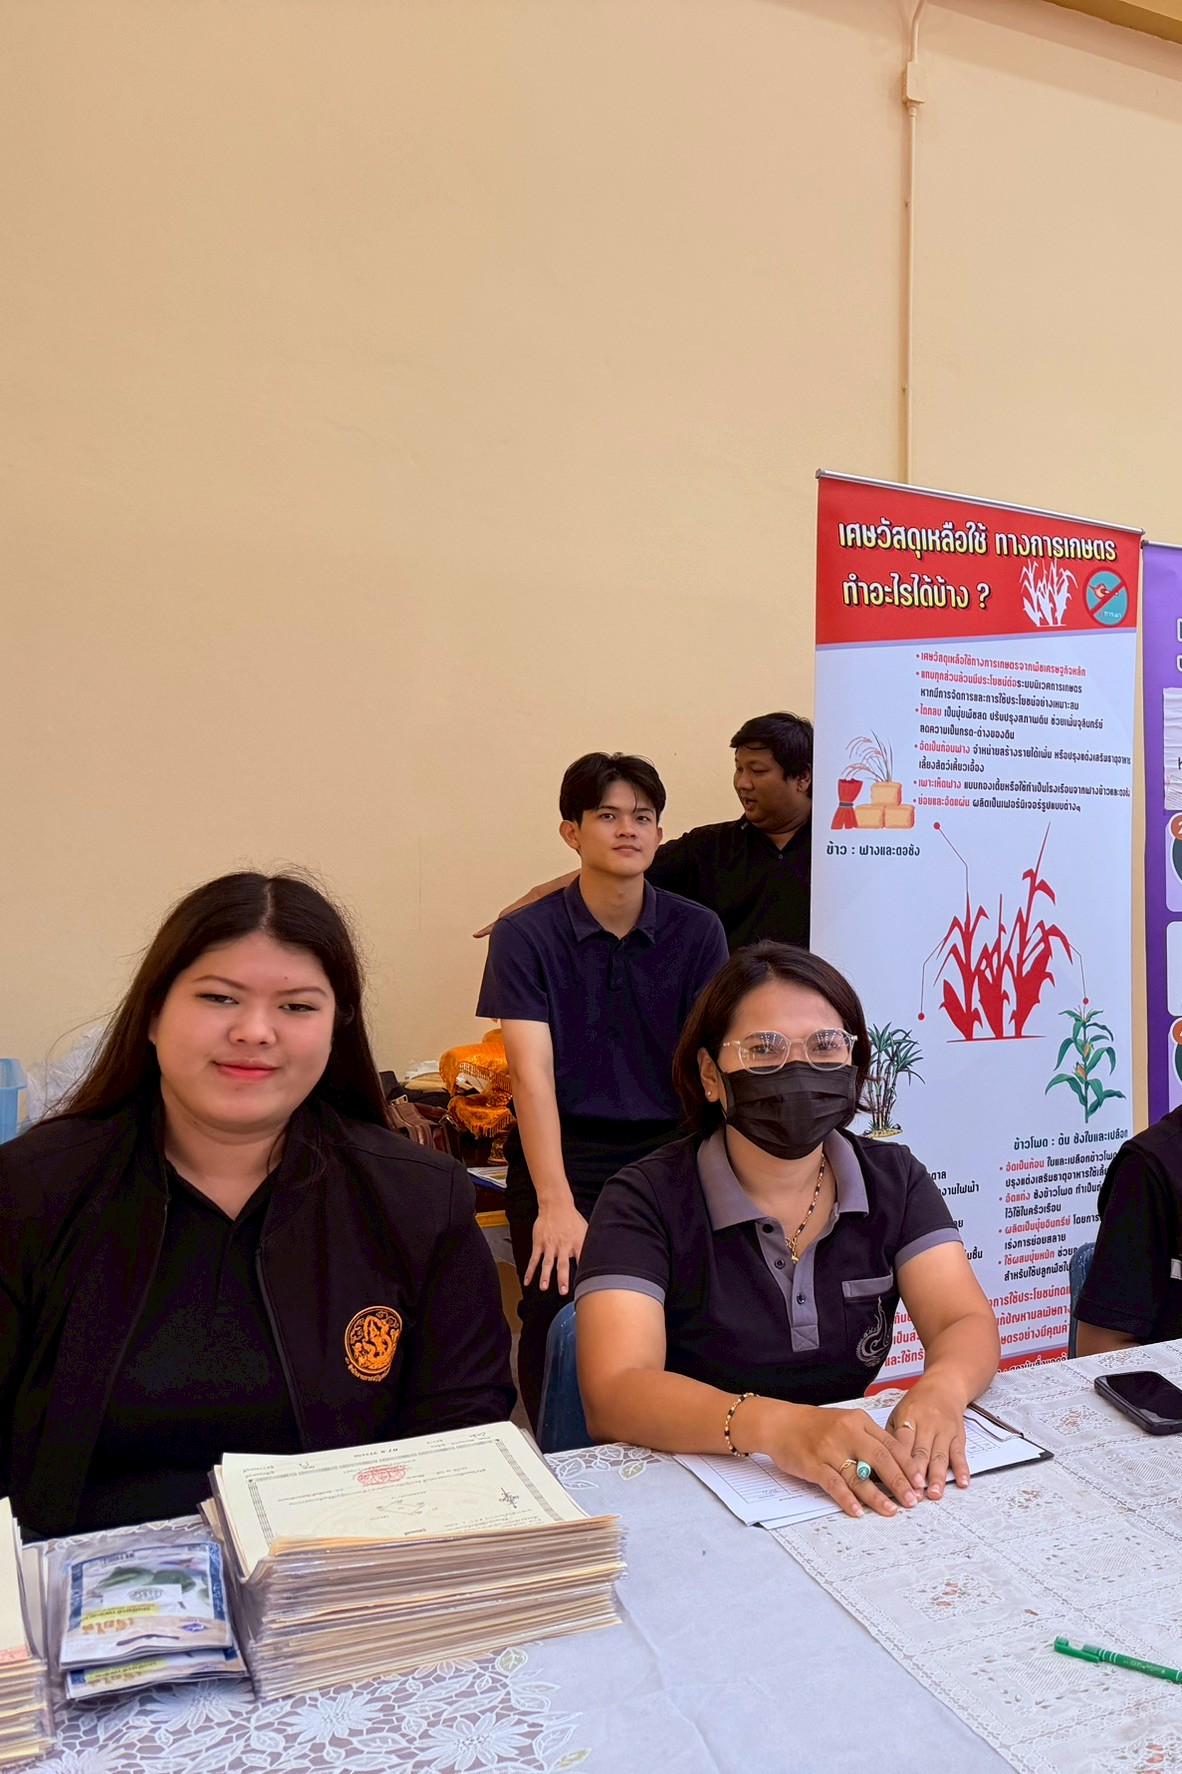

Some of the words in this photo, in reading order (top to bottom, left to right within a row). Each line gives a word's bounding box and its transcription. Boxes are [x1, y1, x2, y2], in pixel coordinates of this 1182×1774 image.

[838, 517, 986, 559] เศษวัสดุเหลือใช้
[995, 535, 1117, 562] ทางการเกษตร
[842, 573, 969, 609] ทำอะไรได้บ้าง
[977, 583, 991, 609] ?
[826, 840, 847, 856] ข้าว
[859, 843, 921, 859] ฟางและตอซัง
[1014, 1136, 1048, 1150] ข้าวโพด
[1058, 1132, 1070, 1146] ต้น
